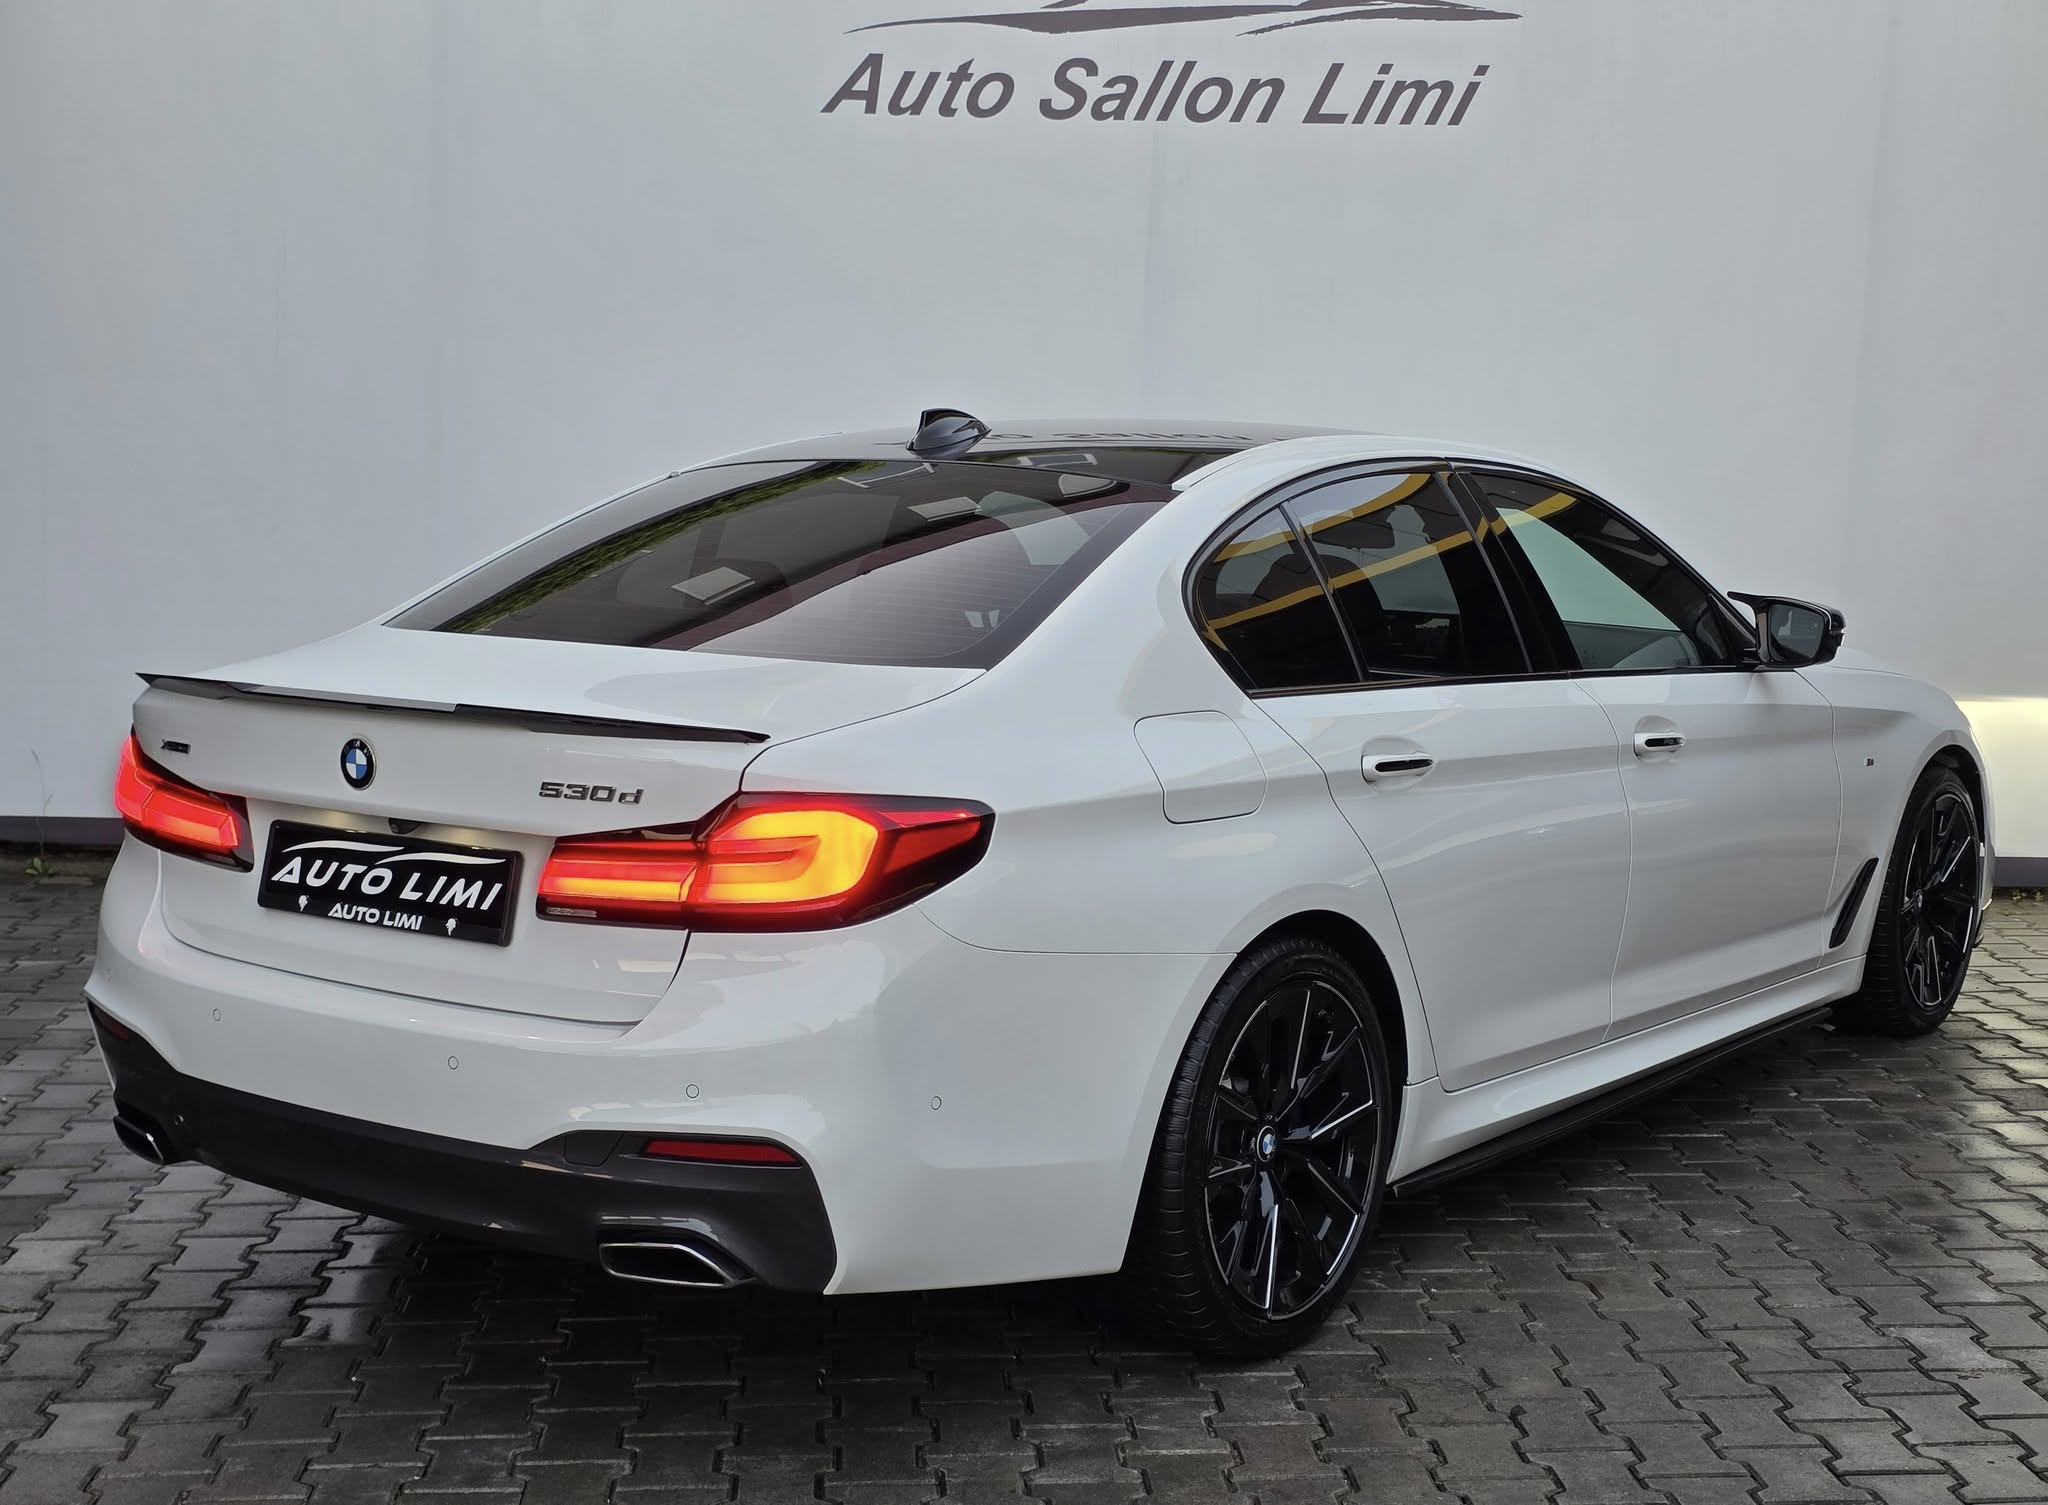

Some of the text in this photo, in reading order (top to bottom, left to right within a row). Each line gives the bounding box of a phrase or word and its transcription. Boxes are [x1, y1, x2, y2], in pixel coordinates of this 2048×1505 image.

[821, 53, 1490, 126] Auto Sallon Limi
[539, 781, 644, 805] 530d
[271, 856, 502, 911] AUTO LIMI
[328, 902, 423, 932] AUTO LIMI
